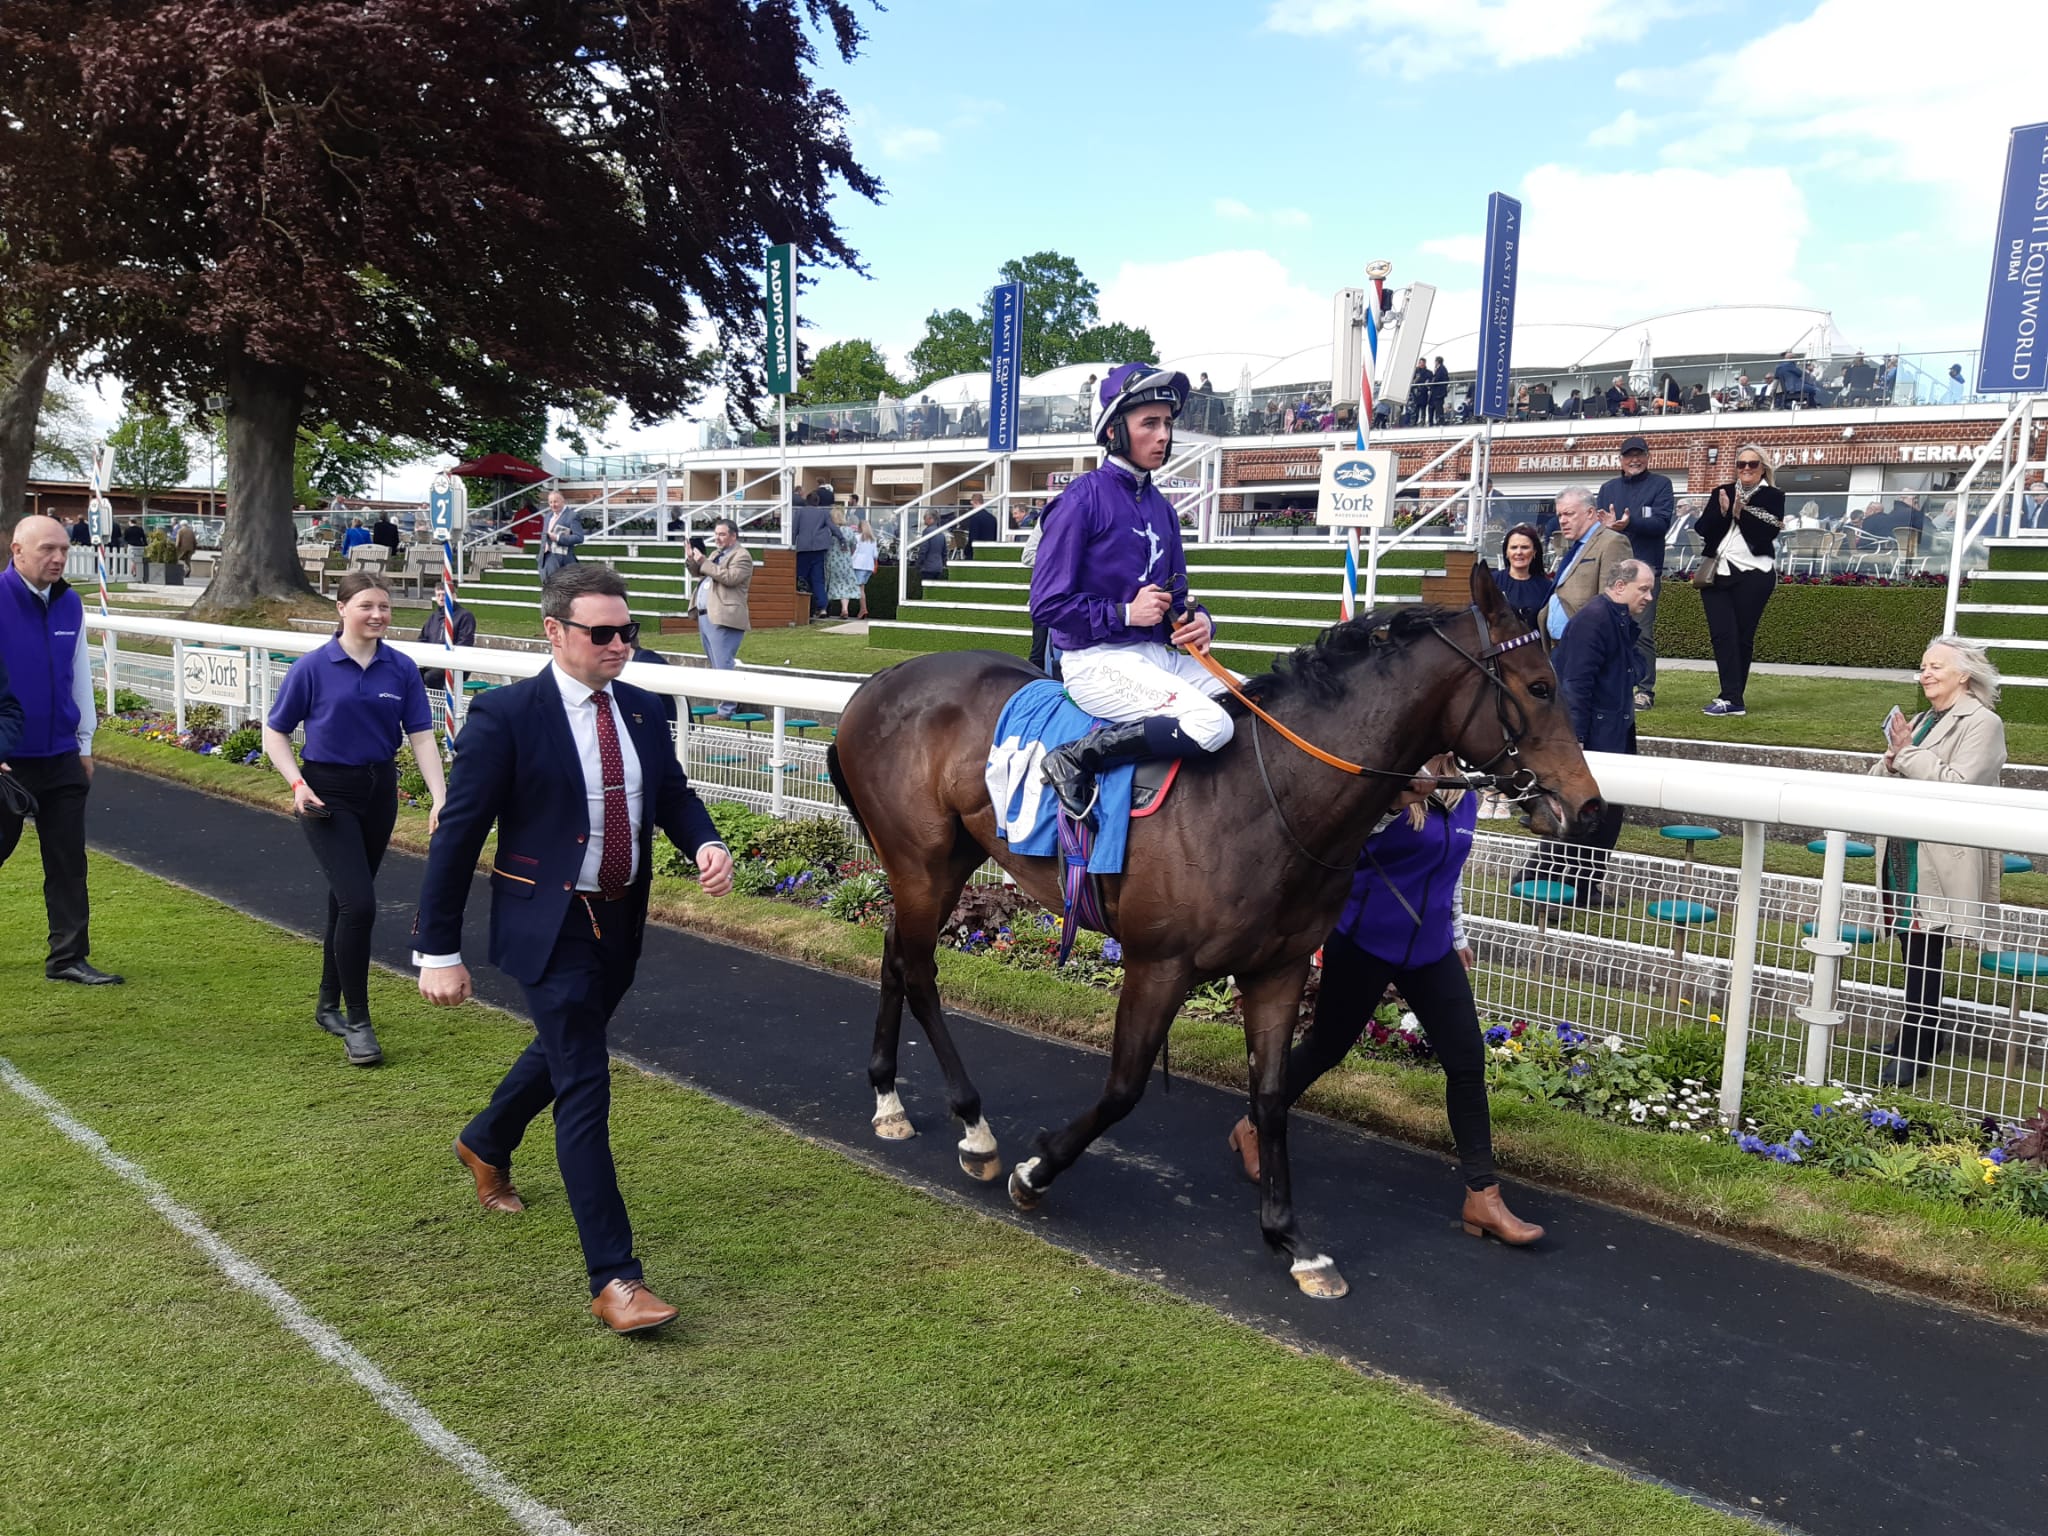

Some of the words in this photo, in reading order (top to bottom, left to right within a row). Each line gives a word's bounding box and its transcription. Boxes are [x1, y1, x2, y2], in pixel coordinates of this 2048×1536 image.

[1506, 209, 1516, 233] AL
[1502, 241, 1514, 289] BASTI
[2007, 239, 2024, 282] DUBAI
[770, 259, 787, 375] PADDYPOWER
[1003, 292, 1012, 311] AL
[1493, 290, 1501, 325] DUBAI
[2011, 241, 2048, 381] EQUIWORLD
[1003, 314, 1012, 353] BASTI
[1494, 296, 1510, 408] EQUIWORLD
[999, 357, 1011, 445] EQUIWORLD
[1518, 455, 1585, 470] ENABLE
[1587, 454, 1622, 469] BAR
[1899, 445, 2004, 461] TERRACE
[1331, 493, 1374, 512] York
[207, 656, 238, 687] York
